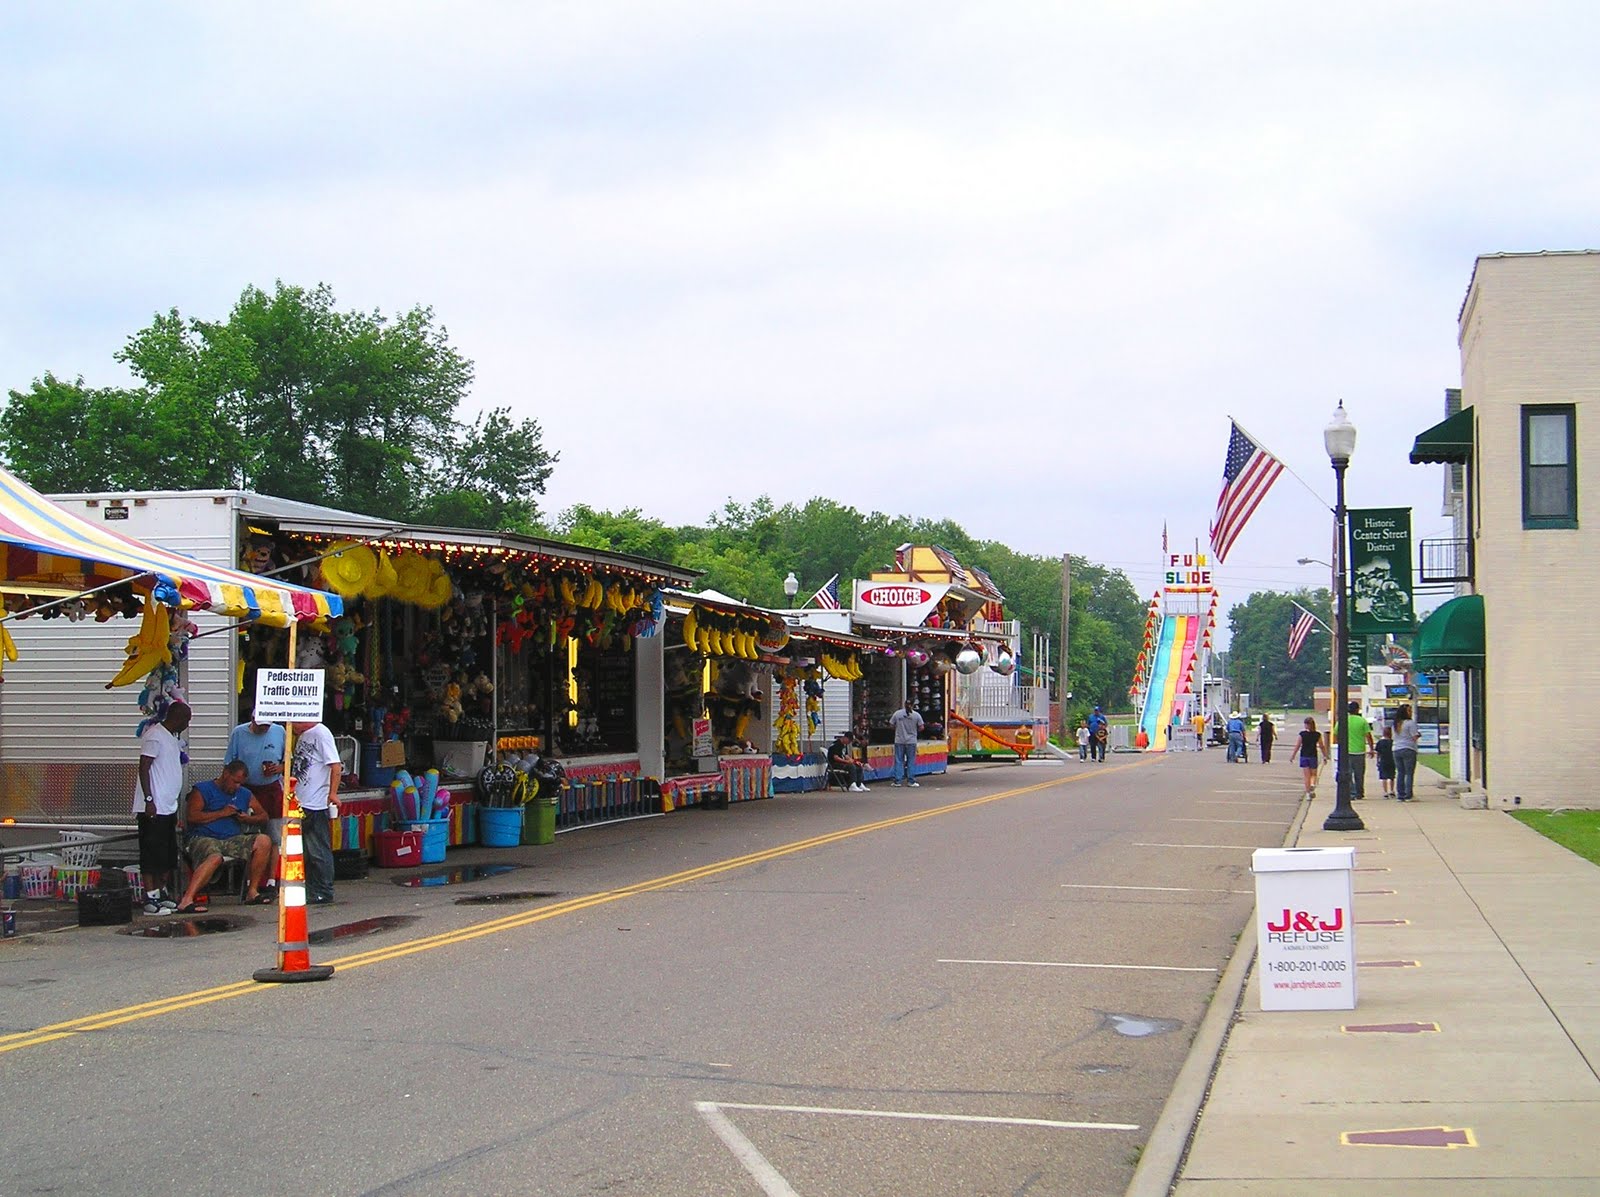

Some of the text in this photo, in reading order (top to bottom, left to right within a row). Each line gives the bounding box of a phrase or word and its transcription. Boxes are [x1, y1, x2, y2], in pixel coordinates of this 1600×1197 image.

[1364, 518, 1396, 528] Historic
[1353, 528, 1408, 540] Center Street
[1366, 542, 1396, 552] District
[1171, 554, 1206, 567] FUN
[1166, 571, 1211, 584] SLIDE
[870, 588, 922, 605] CHOICE
[267, 671, 315, 682] Pedestrian
[263, 685, 318, 697] Traffic ONLY!!
[1267, 908, 1343, 932] J&J
[1268, 931, 1345, 943] REFUSE
[1268, 960, 1347, 972] 1-800-201-0005
